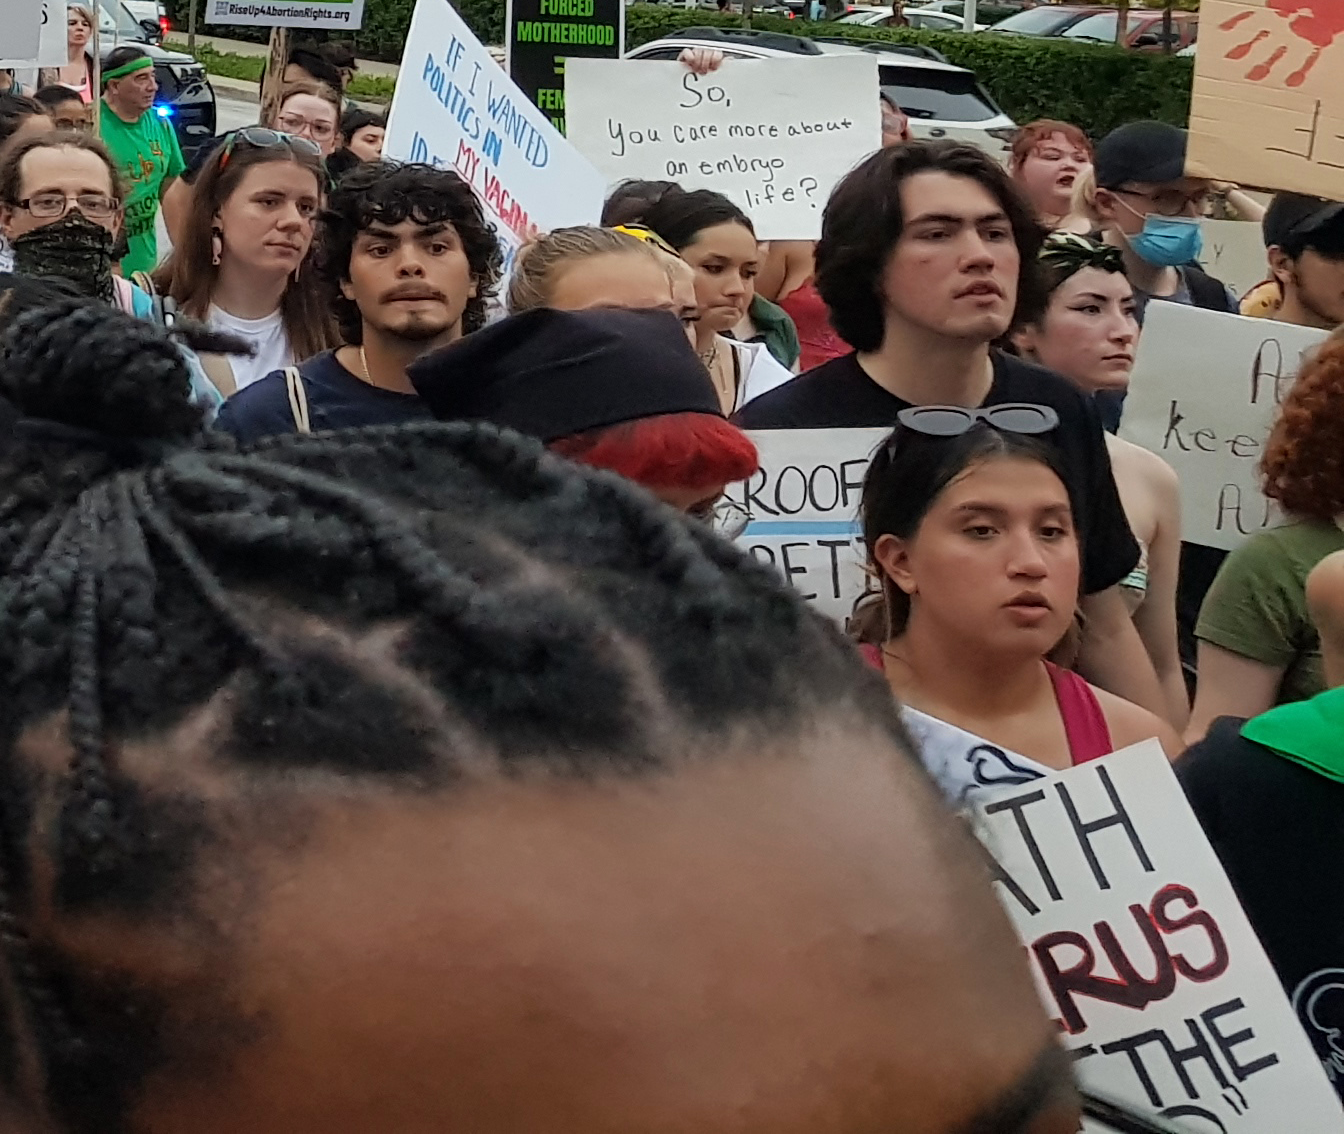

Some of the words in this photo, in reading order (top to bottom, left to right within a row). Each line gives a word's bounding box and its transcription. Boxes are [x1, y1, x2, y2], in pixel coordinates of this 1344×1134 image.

[229, 3, 351, 22] RiseUp4AbortionRights.org
[517, 20, 615, 46] MOTHERHOOD
[445, 34, 465, 73] IF
[468, 61, 482, 97] I
[487, 80, 549, 168] WANTED
[680, 72, 731, 108] So,
[422, 53, 482, 141] POLITICS
[482, 128, 503, 167] IN
[728, 121, 779, 138] more
[788, 118, 853, 136] about
[455, 138, 480, 183] MY
[666, 160, 689, 176] an
[699, 154, 785, 183] embryo
[746, 177, 818, 208] life?
[1031, 882, 1230, 1035] RUS
[1101, 997, 1279, 1108] THE
